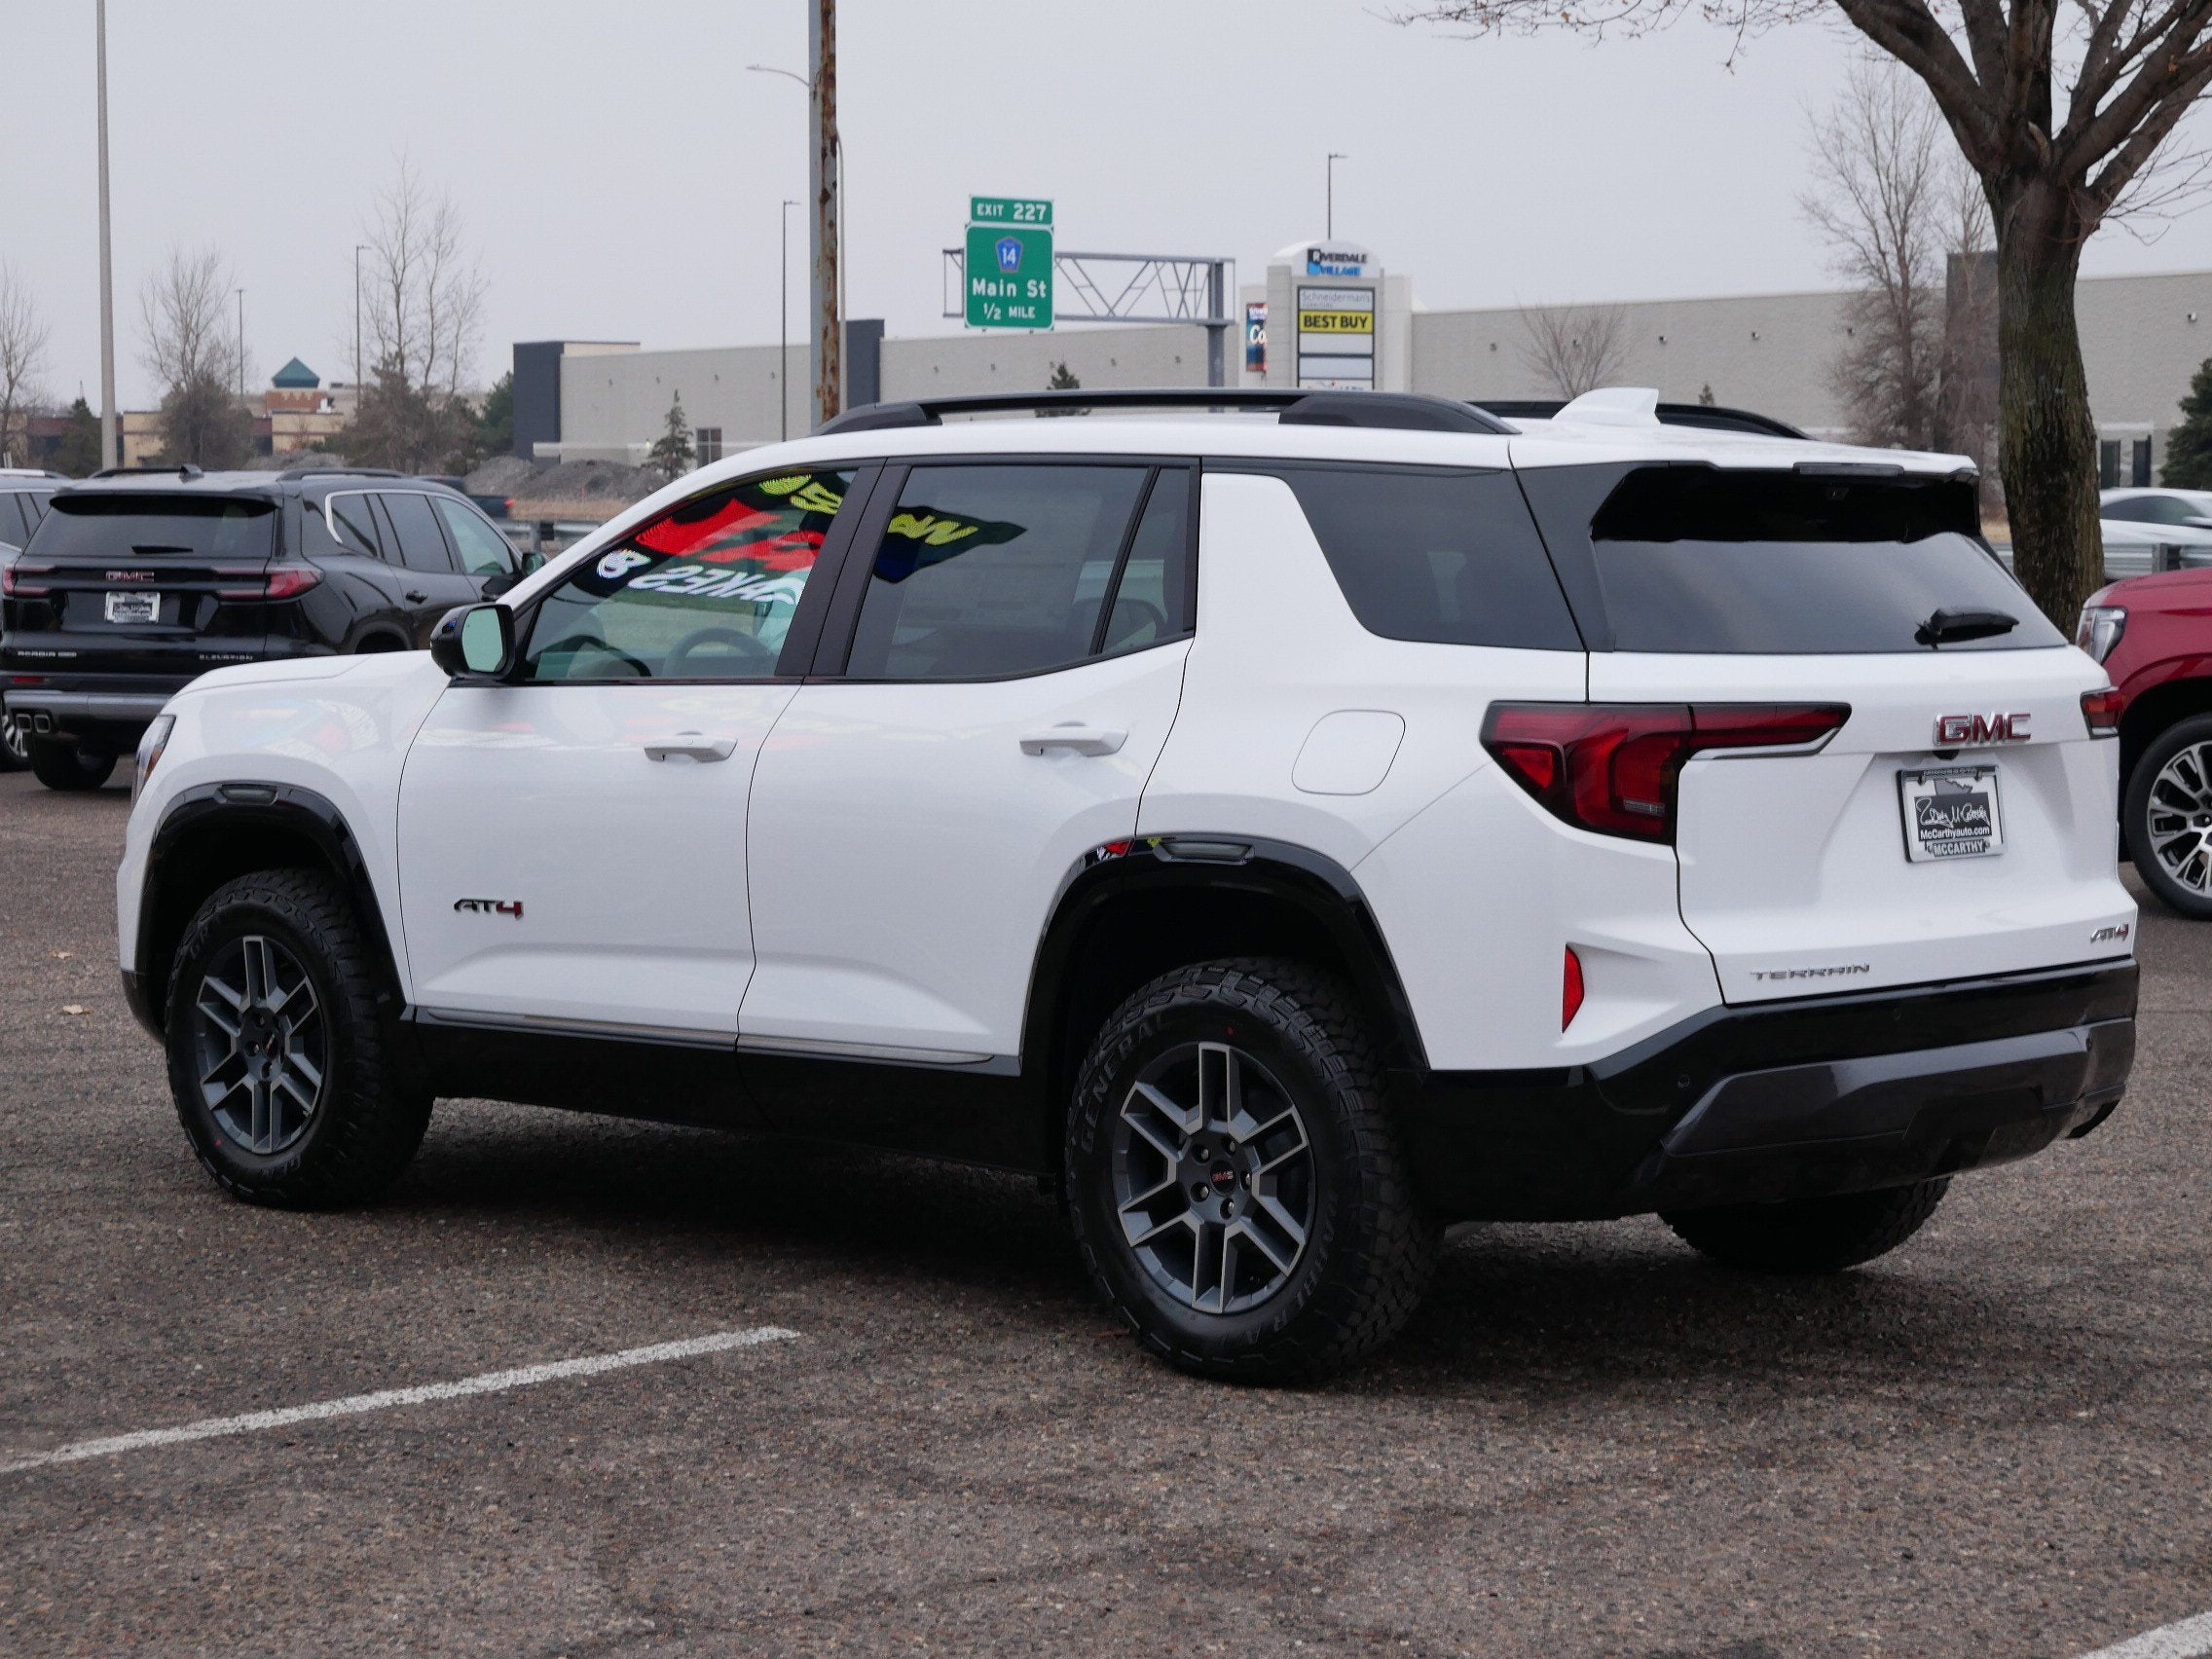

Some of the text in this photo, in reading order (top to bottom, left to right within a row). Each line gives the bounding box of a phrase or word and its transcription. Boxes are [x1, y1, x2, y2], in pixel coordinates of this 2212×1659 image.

[977, 203, 1047, 221] EXIT 227
[1002, 247, 1016, 265] 14
[973, 277, 1047, 298] Main St
[1009, 306, 1036, 318] MILE
[1304, 314, 1368, 329] BEST BUY
[105, 571, 155, 582] GMC
[1934, 712, 2032, 746] GMC
[1920, 827, 1990, 841] McCarthyauto.com
[1934, 840, 1985, 856] MCCARTHY
[454, 899, 524, 919] AT4
[2090, 923, 2129, 943] AT4
[1751, 963, 1870, 980] TERRAIN
